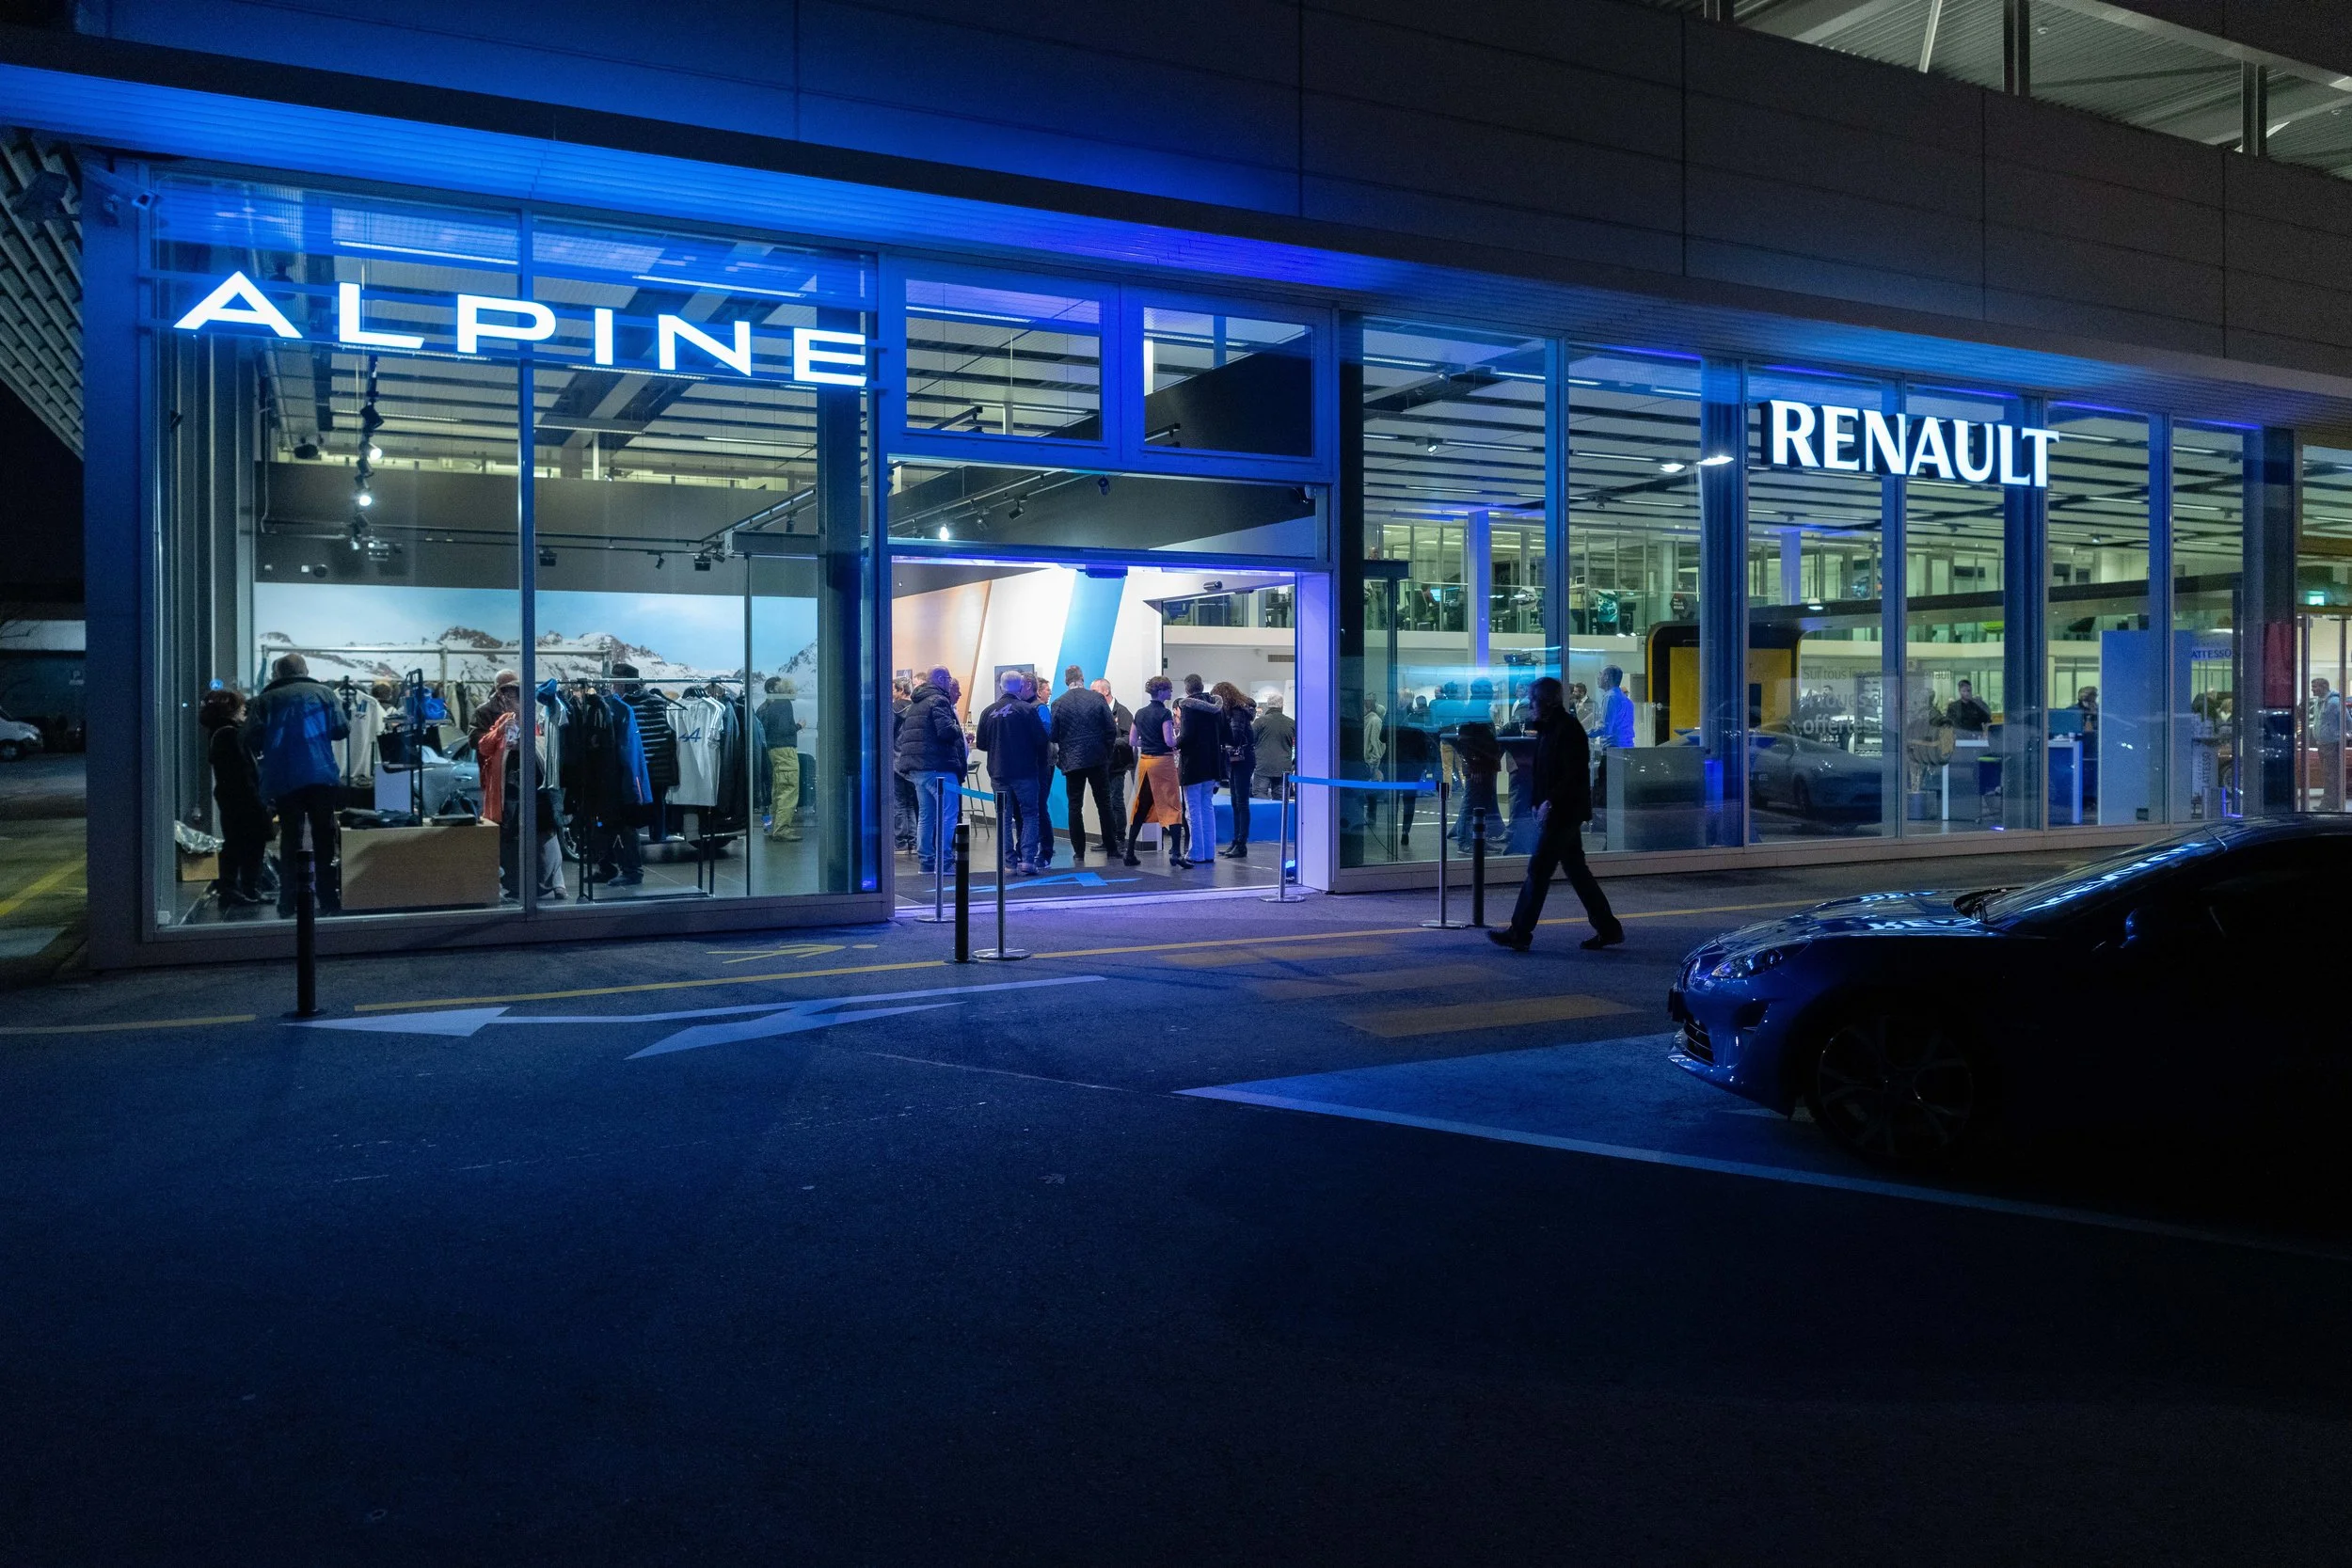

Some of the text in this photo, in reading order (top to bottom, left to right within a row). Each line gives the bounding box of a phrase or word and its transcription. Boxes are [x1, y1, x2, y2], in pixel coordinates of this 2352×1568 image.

[173, 271, 867, 387] ALPINE
[1770, 400, 2060, 487] RENAULT
[2191, 649, 2232, 658] ATTESSO
